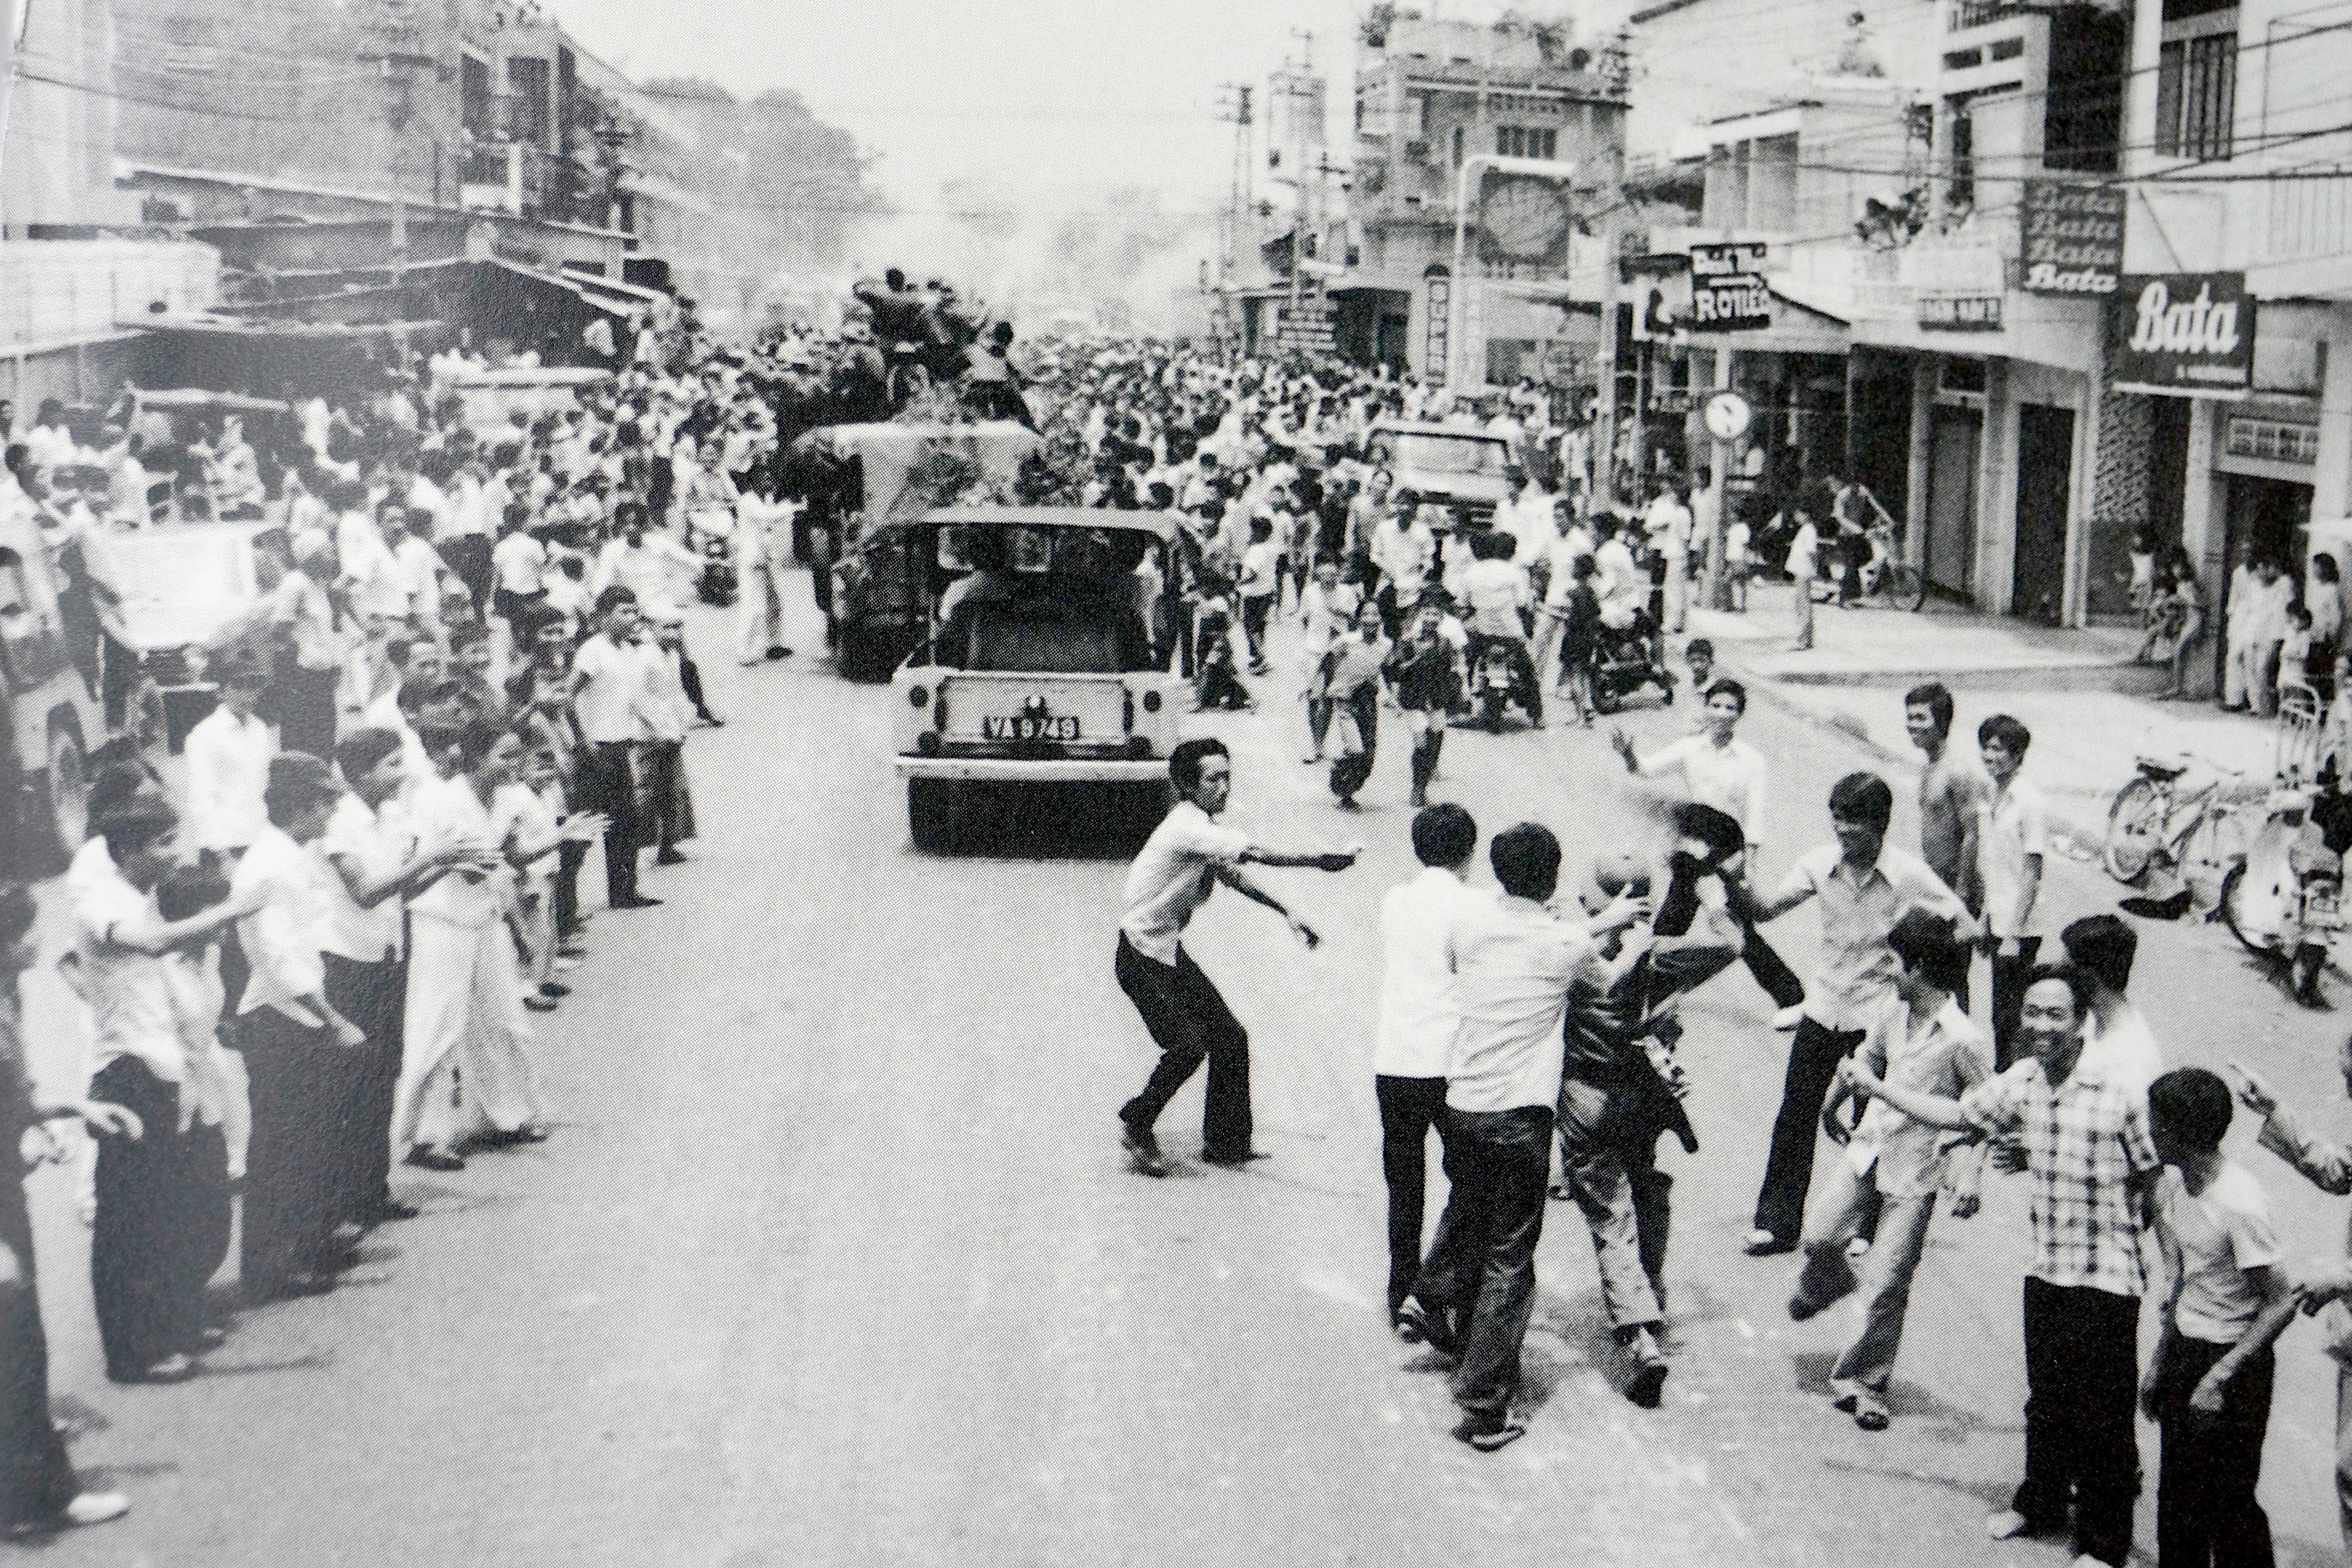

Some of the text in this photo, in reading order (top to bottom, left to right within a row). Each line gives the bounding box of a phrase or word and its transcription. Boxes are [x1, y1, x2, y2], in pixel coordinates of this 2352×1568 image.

[2028, 185, 2118, 214] Bata
[2027, 212, 2118, 239] Bata
[2027, 238, 2117, 265] Bata
[2023, 263, 2118, 292] Bata
[2129, 281, 2241, 355] Bata
